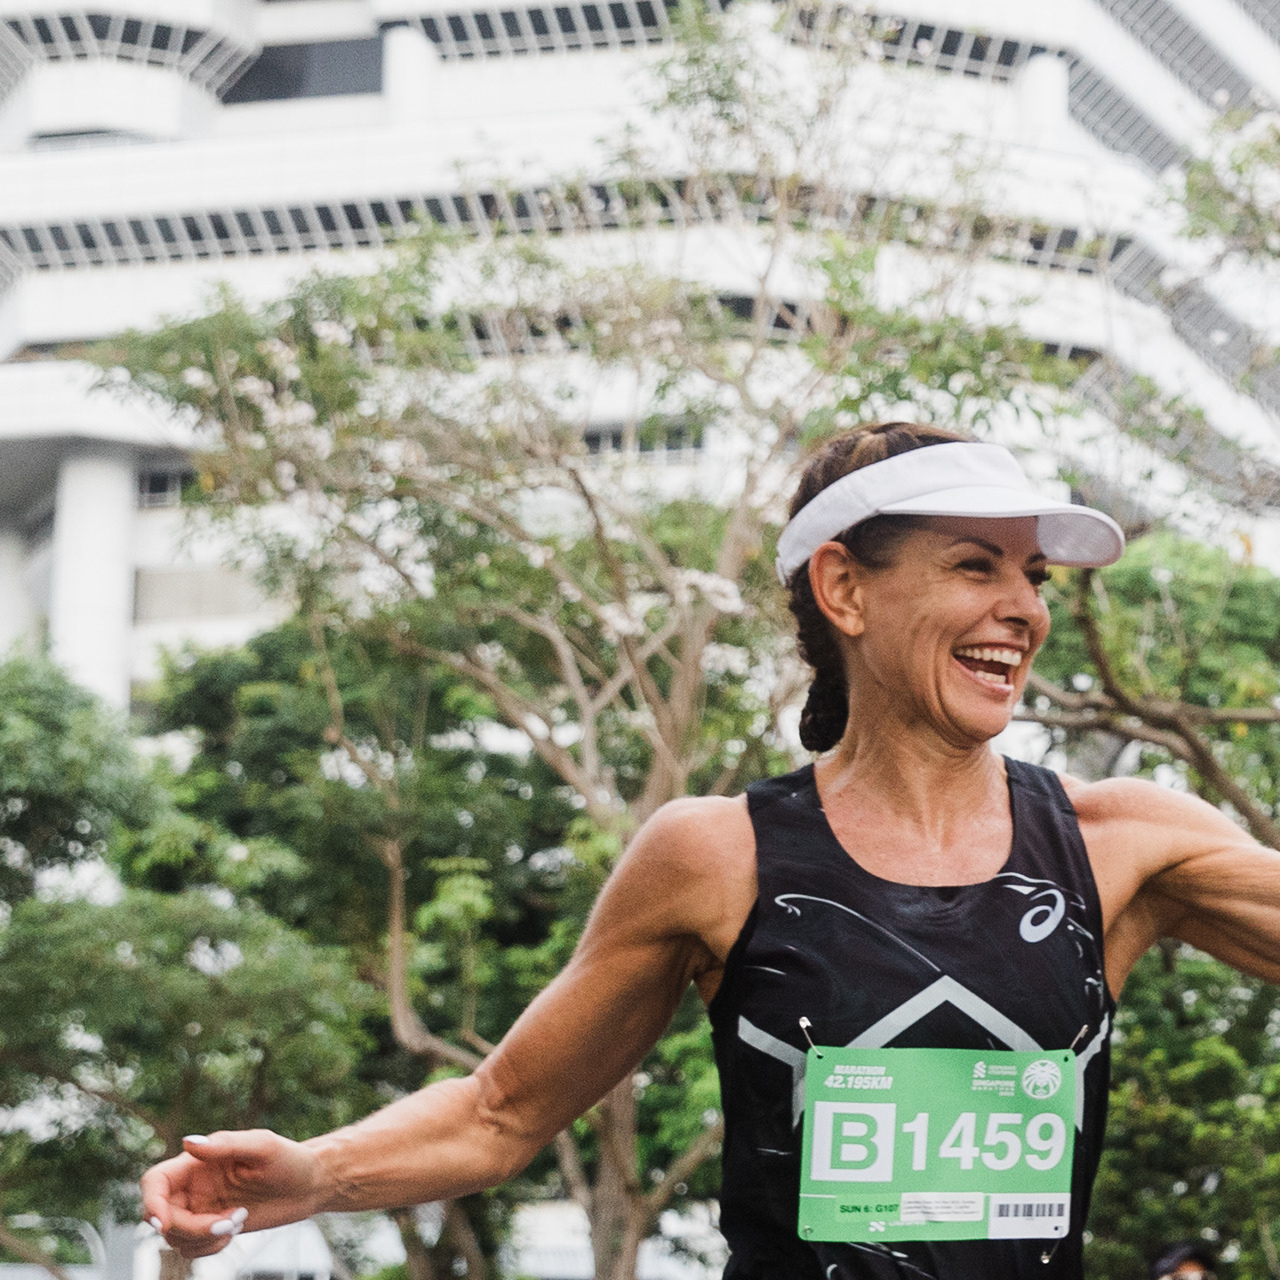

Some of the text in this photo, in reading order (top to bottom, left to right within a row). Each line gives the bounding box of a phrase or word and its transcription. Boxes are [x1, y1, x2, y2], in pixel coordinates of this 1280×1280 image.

[824, 1074, 894, 1090] 42.195KM
[829, 1111, 1067, 1171] B 1459
[839, 1204, 861, 1214] SUN
